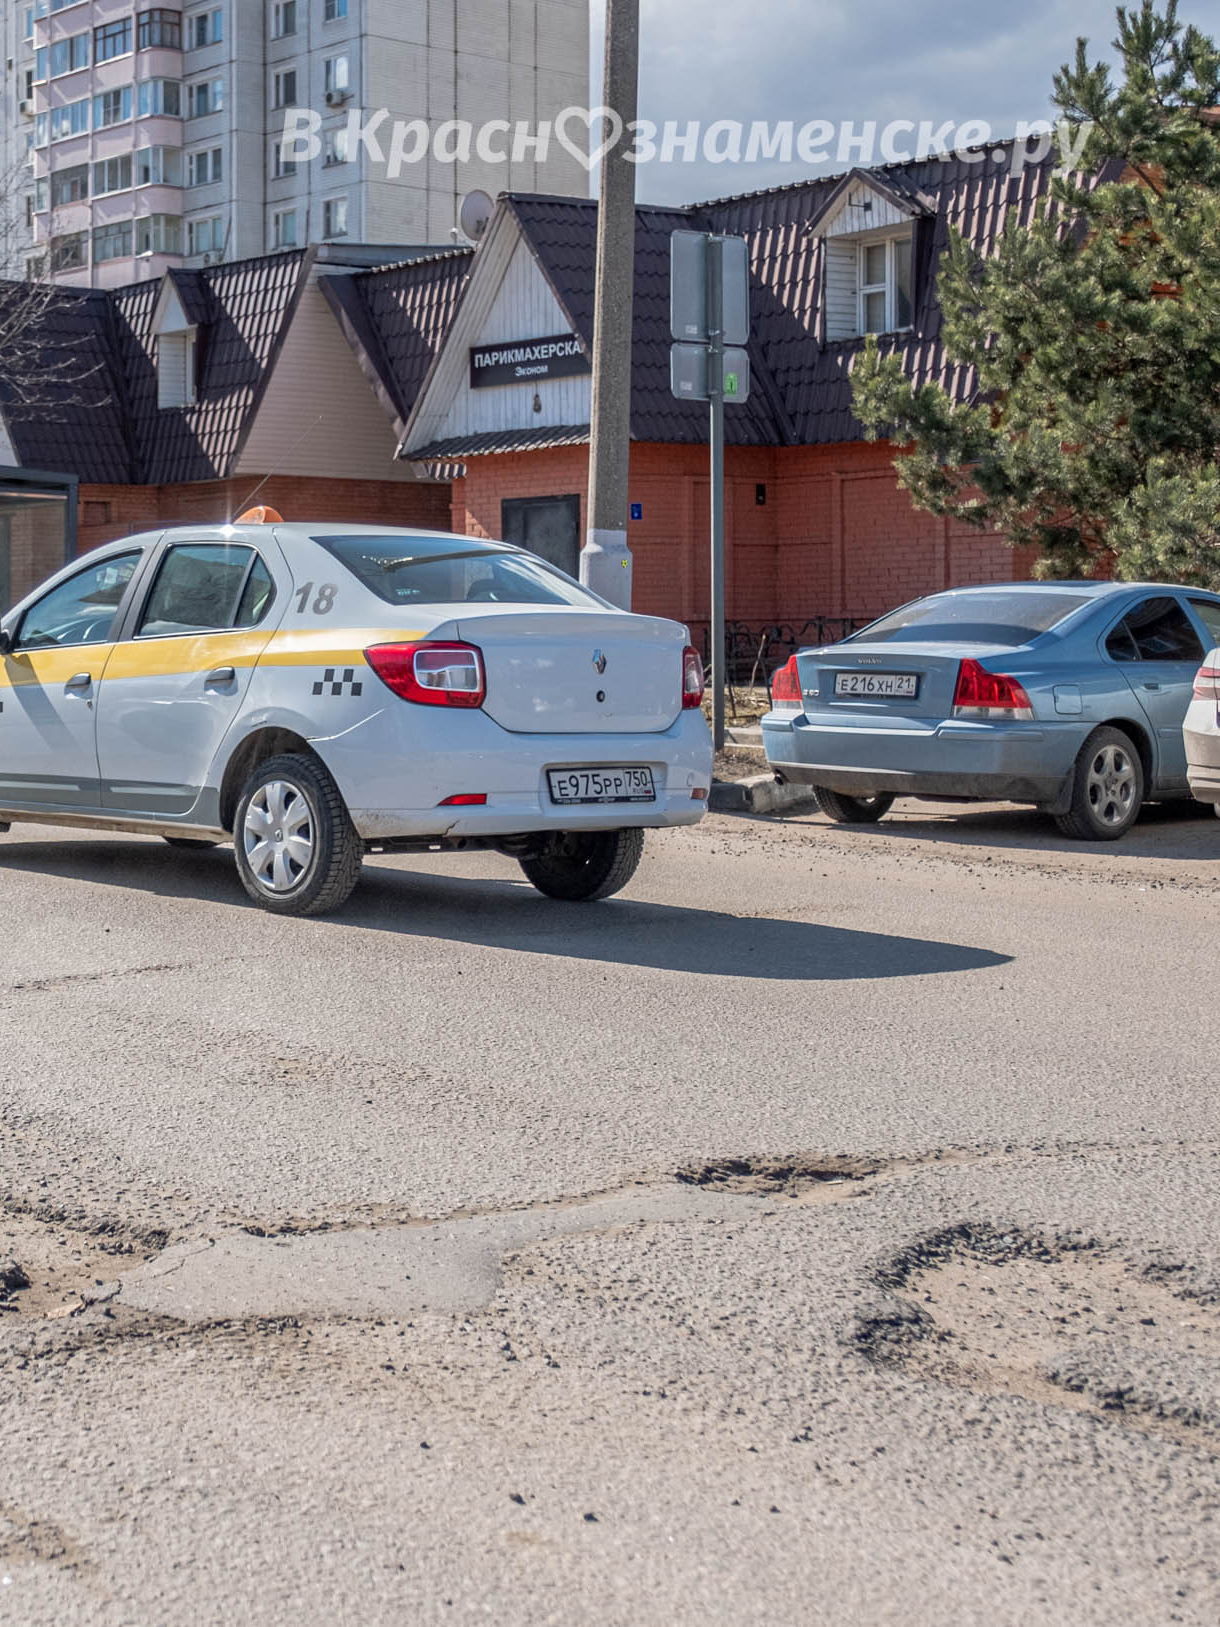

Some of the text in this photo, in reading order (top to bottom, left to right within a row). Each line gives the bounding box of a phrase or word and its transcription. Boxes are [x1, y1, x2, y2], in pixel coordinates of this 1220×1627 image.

[474, 340, 584, 368] ПАРИКМАХЕРСКА
[515, 364, 548, 376] Эконом
[295, 581, 338, 615] 18
[840, 677, 911, 692] Е216ХН 21
[558, 771, 648, 797] Е975РР 750
